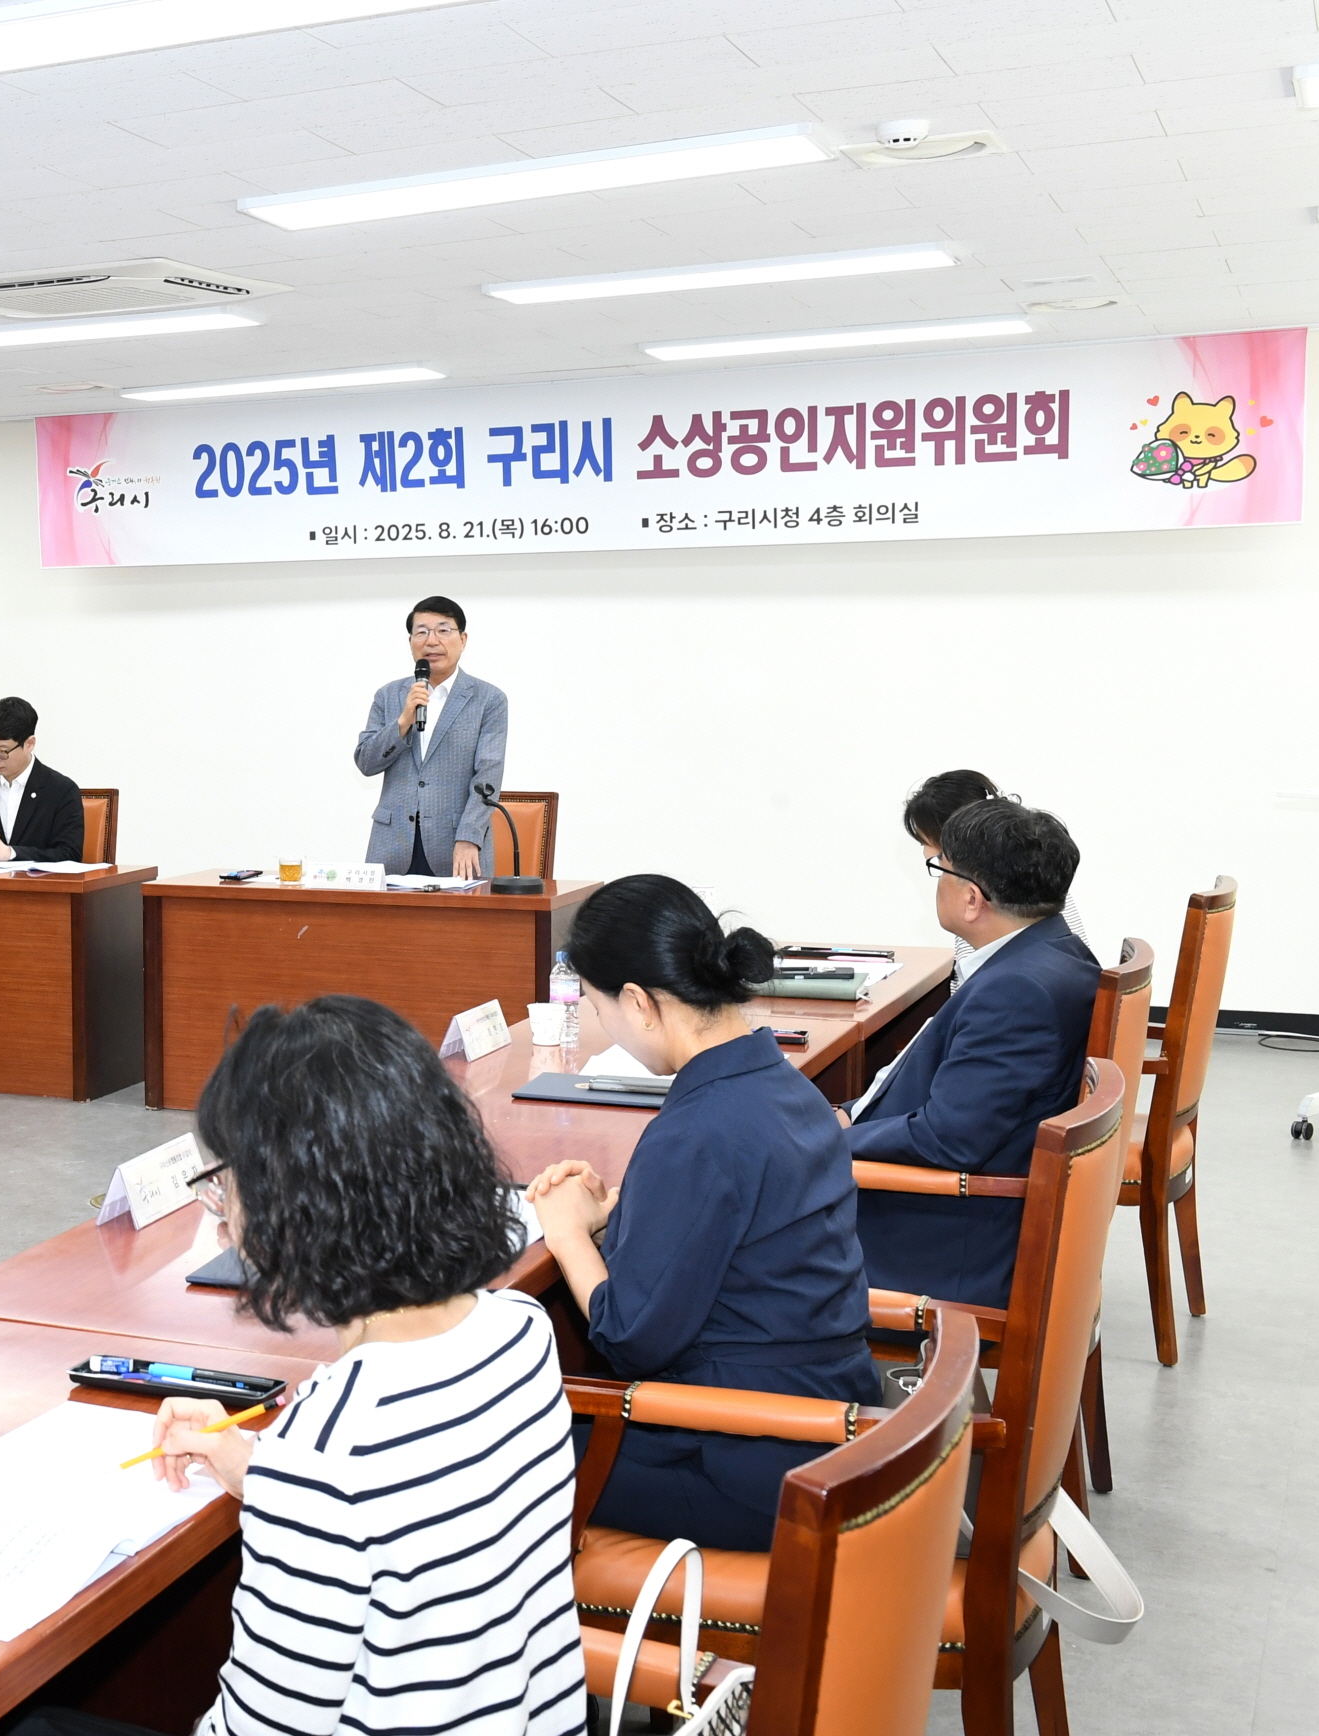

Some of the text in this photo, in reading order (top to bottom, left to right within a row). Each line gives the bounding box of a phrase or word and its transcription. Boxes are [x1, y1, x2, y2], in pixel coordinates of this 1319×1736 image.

[192, 389, 1070, 499] 2025년 제2회 구리시 소상공인지원위원회
[80, 488, 150, 514] 구리시
[322, 524, 357, 546] 일시
[374, 523, 432, 542] 2025.
[438, 521, 457, 540] 8.
[463, 517, 525, 540] 21.(목)
[530, 516, 589, 536] 16:00
[655, 511, 698, 534] 장소
[714, 506, 800, 531] 구리시청
[807, 504, 846, 528] 4층
[852, 501, 919, 526] 회의실
